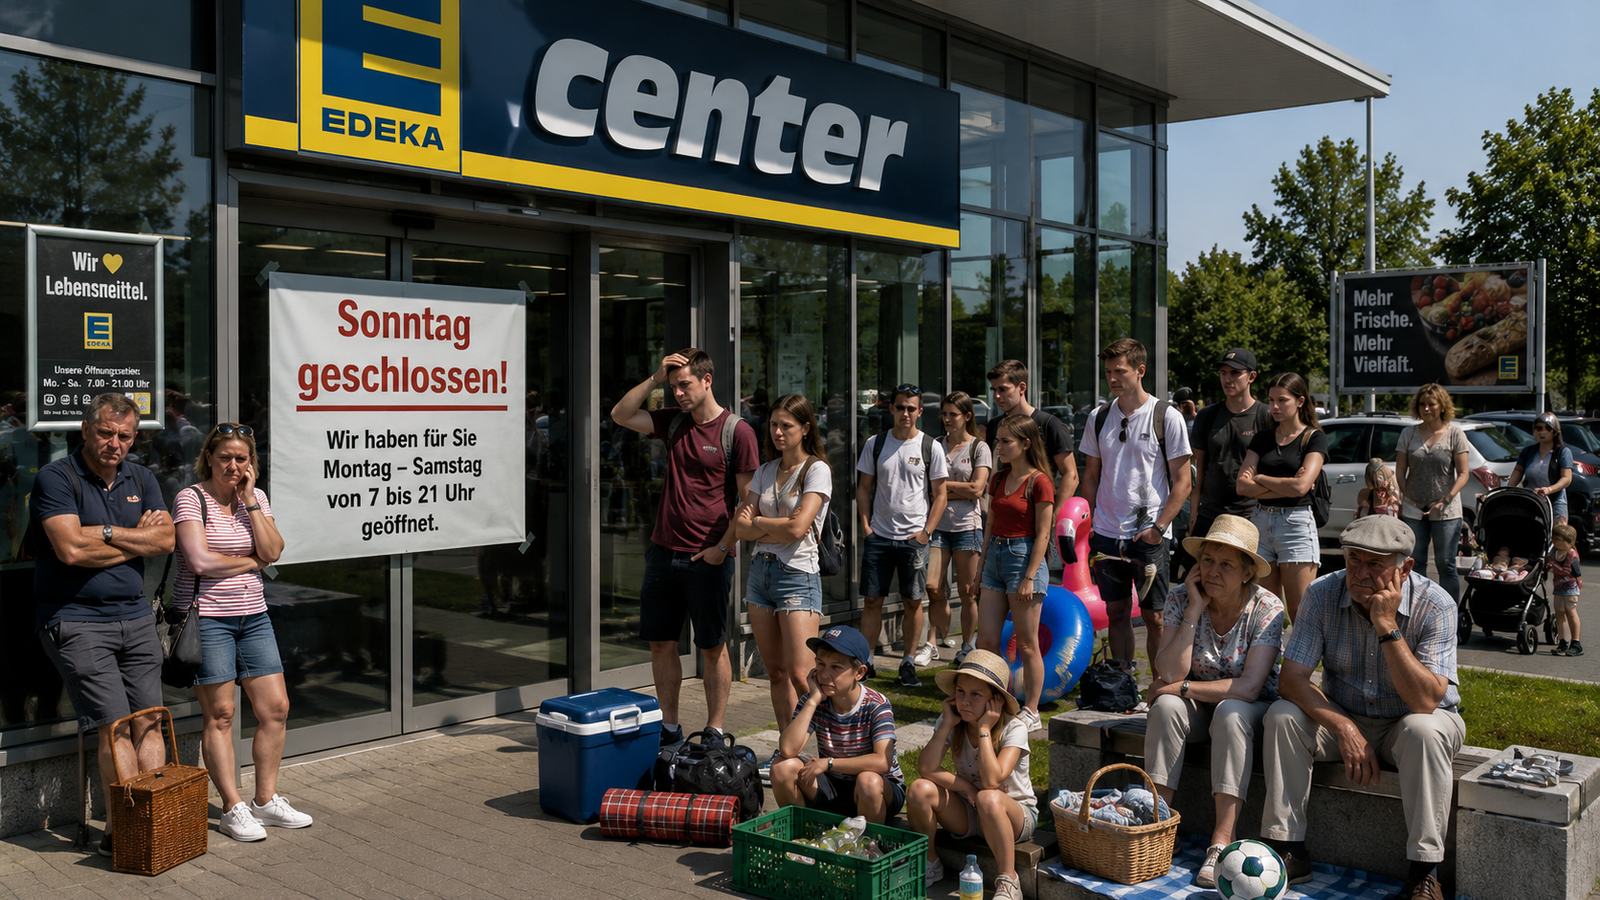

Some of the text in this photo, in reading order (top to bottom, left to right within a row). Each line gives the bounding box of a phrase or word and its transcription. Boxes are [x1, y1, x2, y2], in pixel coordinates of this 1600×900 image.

[534, 38, 909, 192] center
[322, 107, 444, 151] EDEKA
[71, 251, 98, 272] Wir
[1353, 288, 1393, 307] Mehr
[338, 299, 471, 350] Sonntag
[1353, 310, 1413, 329] Frische.
[1353, 333, 1393, 352] Mehr
[43, 378, 60, 388] Mo.
[67, 379, 82, 388] Sa.
[111, 379, 134, 389] 21.00
[136, 379, 150, 389] Uhr
[297, 355, 508, 401] geschlossen!
[326, 428, 477, 450] Wir haben für Sie
[323, 459, 392, 482] Montag
[412, 456, 482, 477] Samstag
[327, 483, 475, 509] von 7 bis 21 Uhr
[361, 513, 440, 541] geöffnet.
